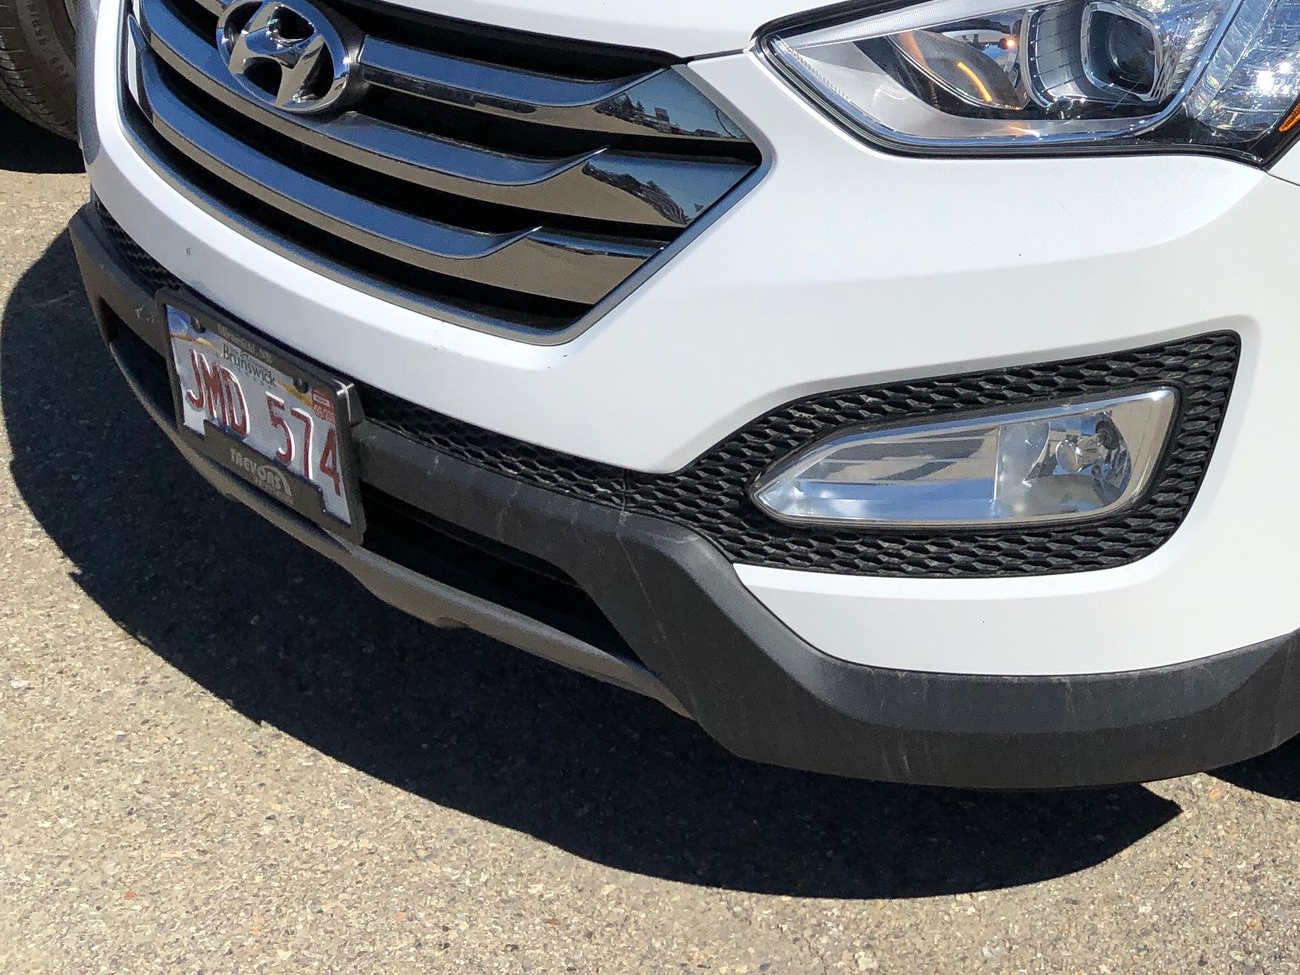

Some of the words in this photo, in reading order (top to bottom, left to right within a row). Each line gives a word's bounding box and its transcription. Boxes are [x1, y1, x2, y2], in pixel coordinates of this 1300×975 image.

[222, 343, 278, 387] Brunswick
[187, 348, 250, 436] JMD
[265, 391, 342, 497] 574
